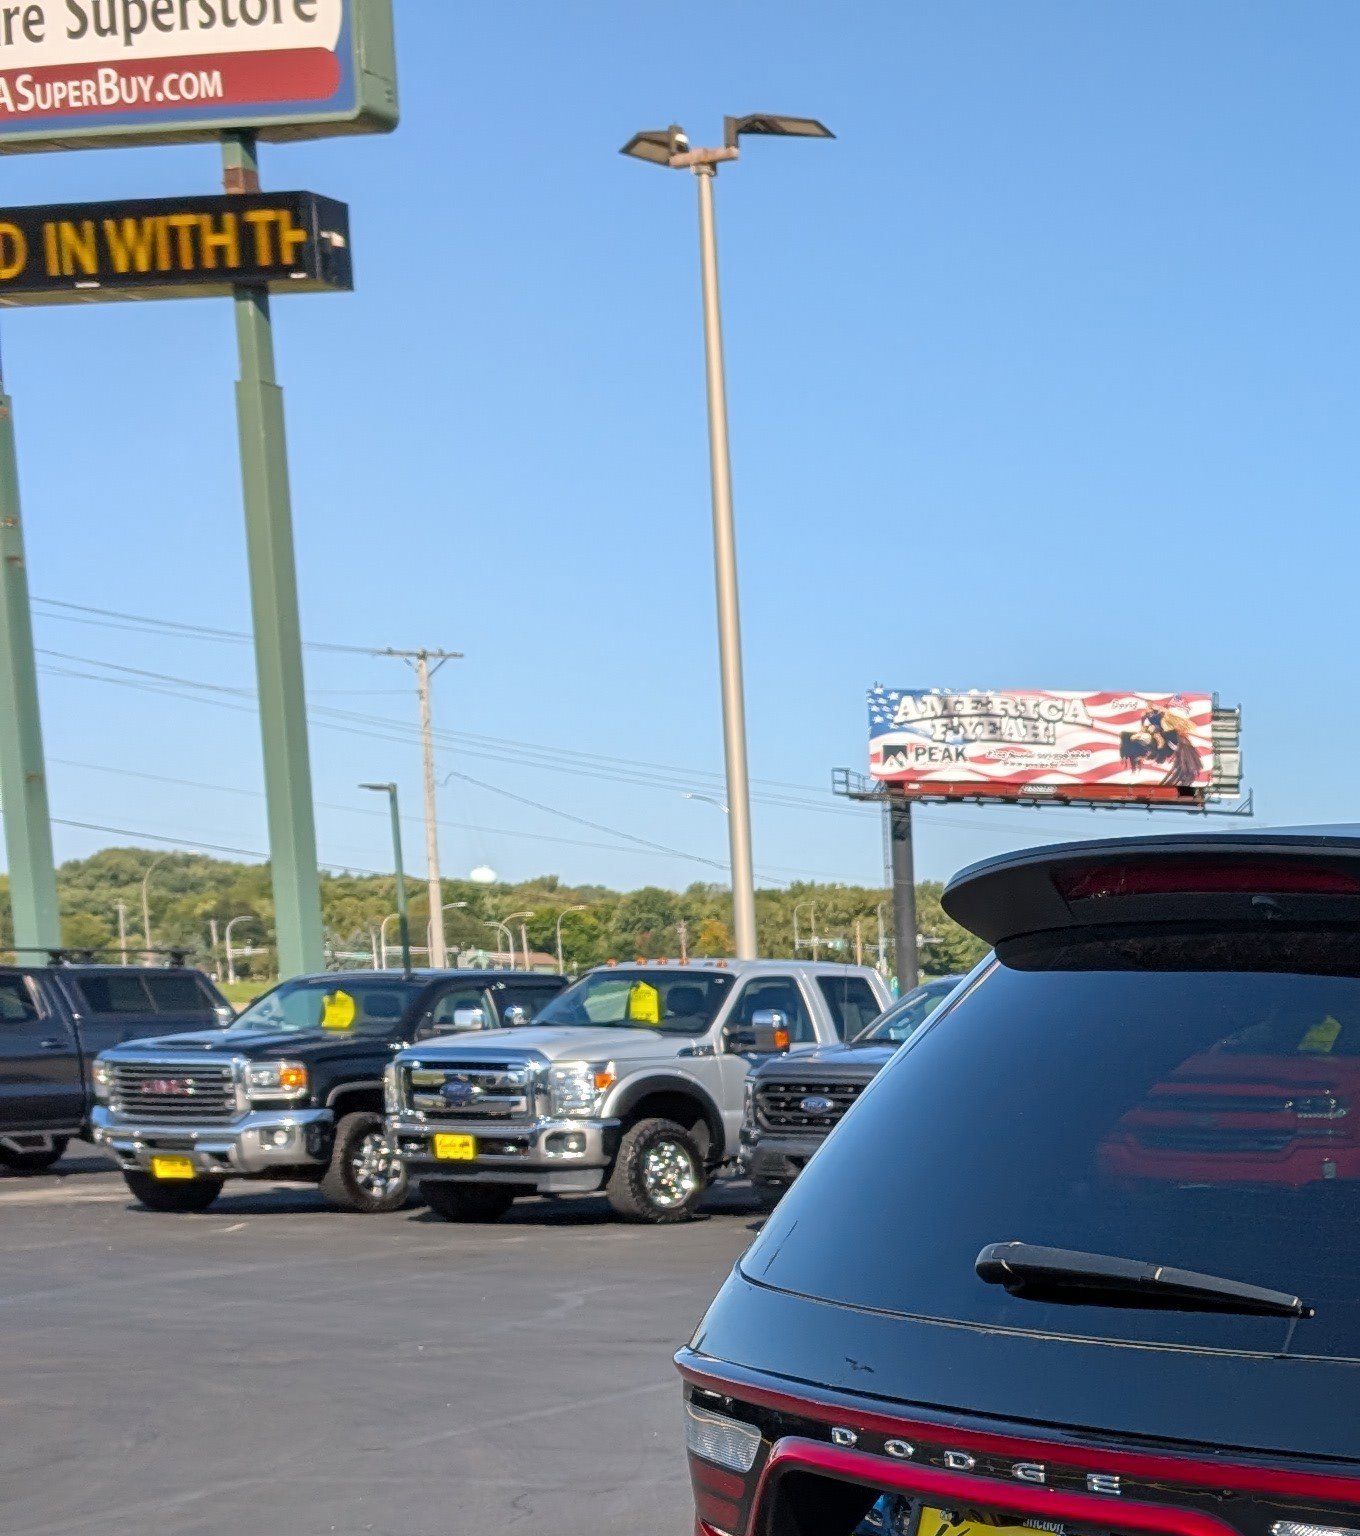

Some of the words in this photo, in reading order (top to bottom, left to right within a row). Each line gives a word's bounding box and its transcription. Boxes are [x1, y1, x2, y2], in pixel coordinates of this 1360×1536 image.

[0, 4, 46, 46] re
[43, 219, 99, 277] IN
[103, 211, 240, 273] WITH
[893, 694, 1093, 727] AMERICA
[914, 746, 968, 762] PEAK
[831, 1426, 1122, 1496] DODGE
